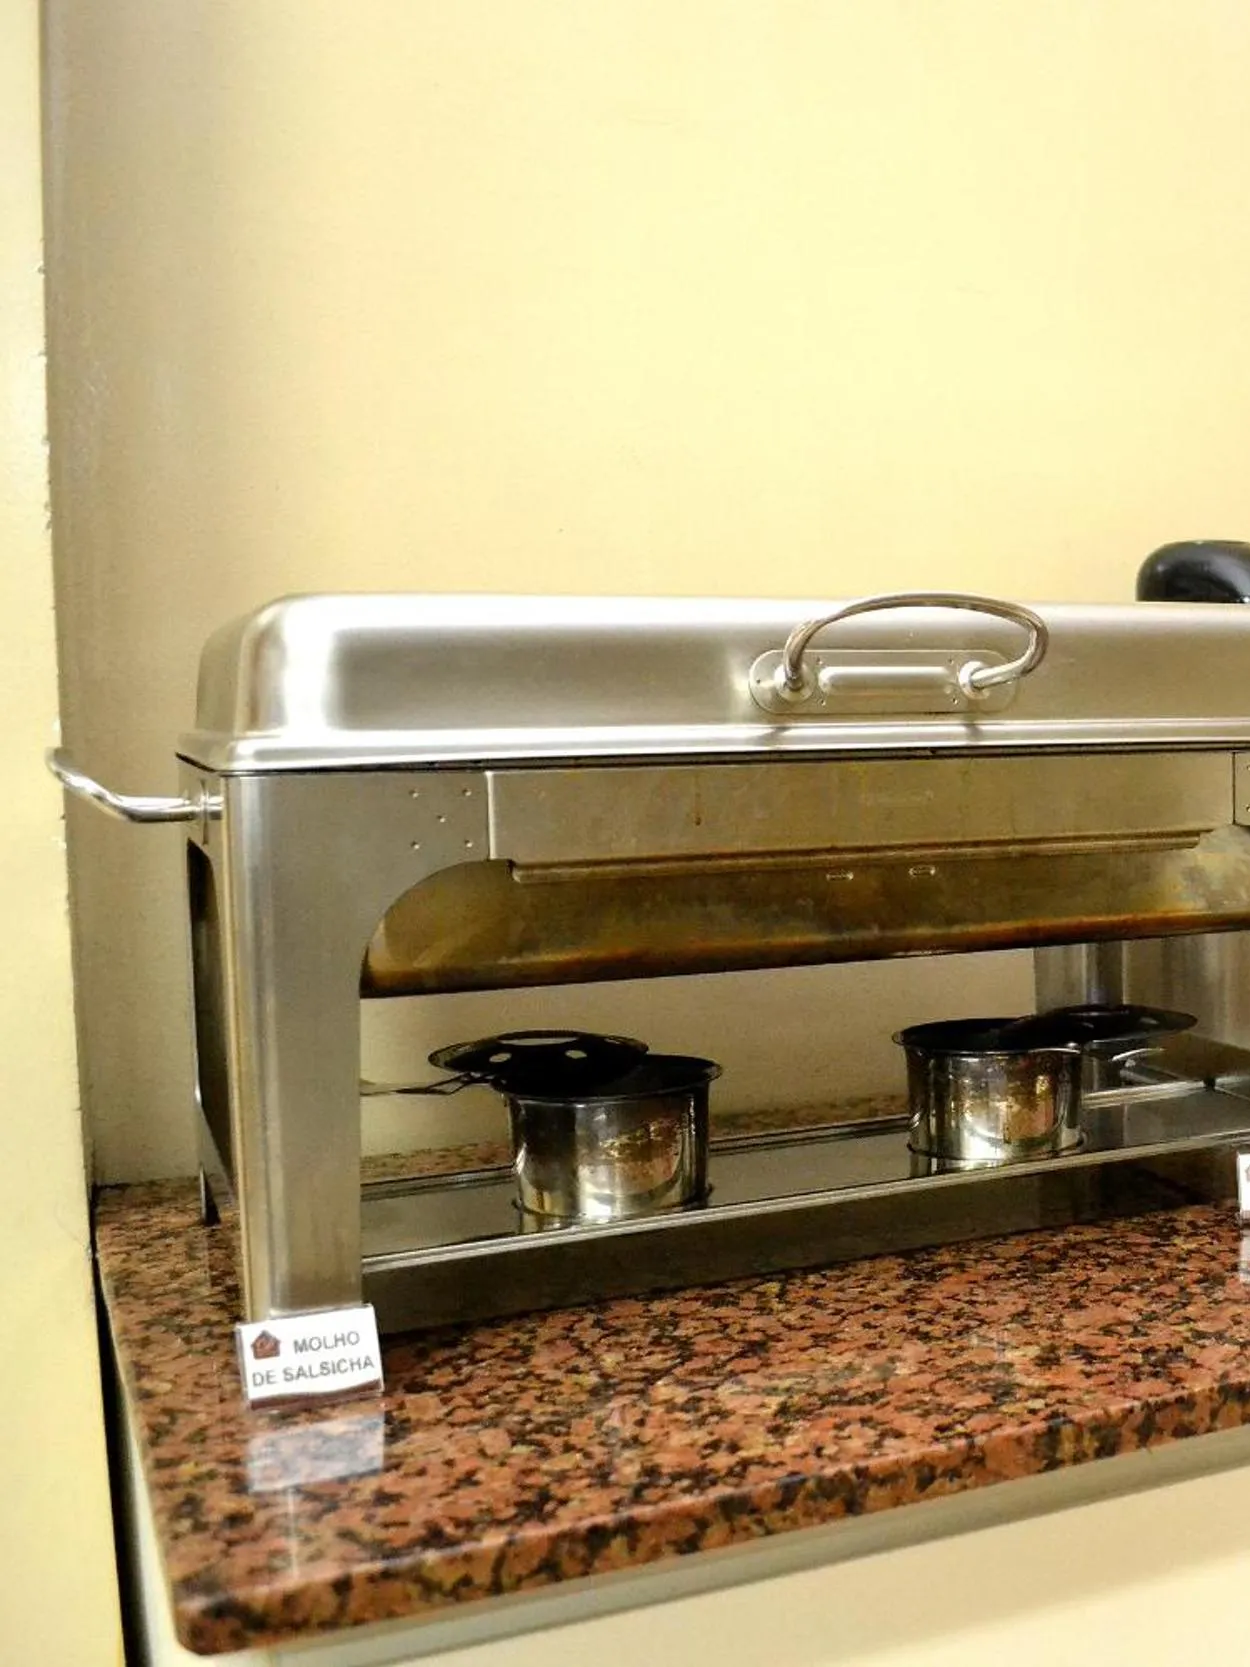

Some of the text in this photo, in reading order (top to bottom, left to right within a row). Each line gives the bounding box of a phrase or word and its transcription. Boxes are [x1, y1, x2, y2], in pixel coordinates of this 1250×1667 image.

[293, 1331, 361, 1355] MOLHO
[252, 1355, 375, 1388] DE SALSICHA
